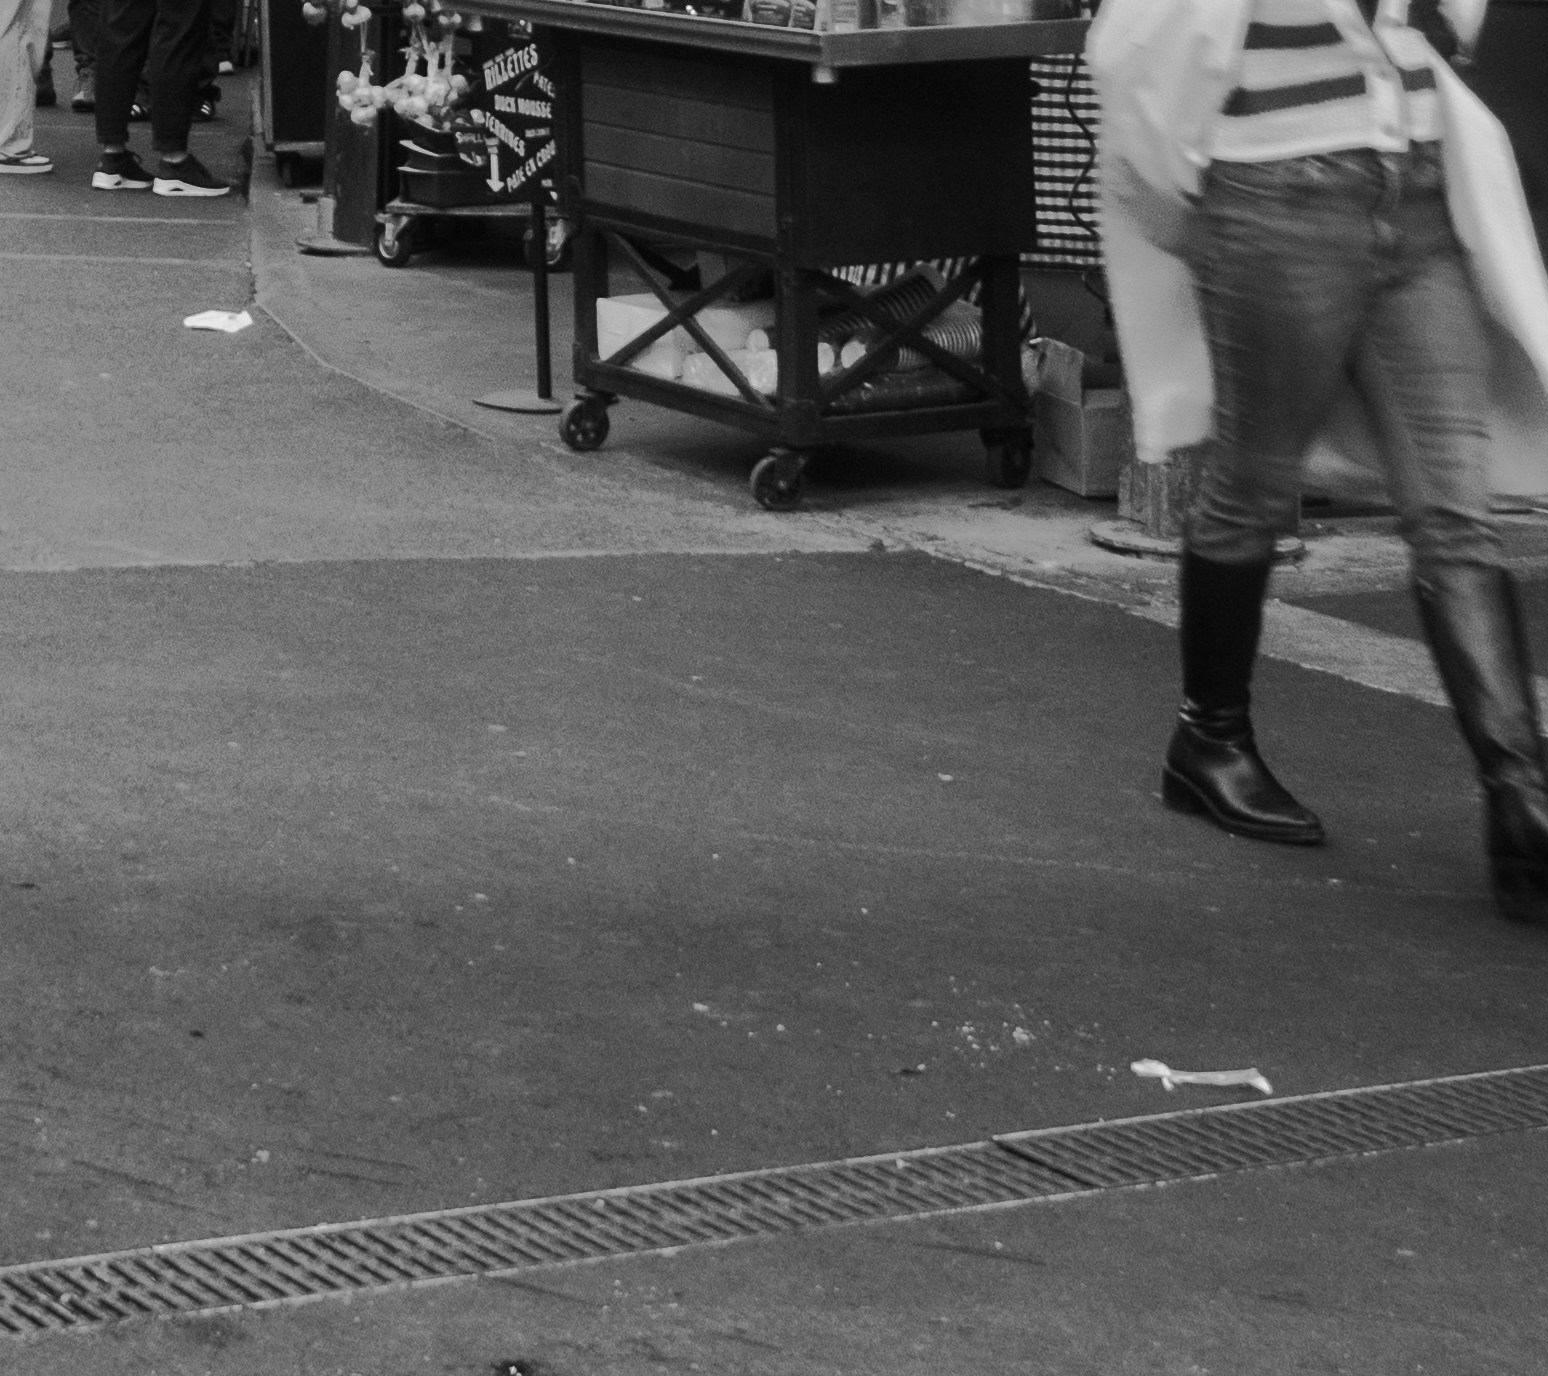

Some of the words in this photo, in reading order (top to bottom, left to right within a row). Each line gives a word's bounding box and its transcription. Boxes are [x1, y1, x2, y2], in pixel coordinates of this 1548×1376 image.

[484, 43, 538, 90] RILLETTES
[494, 94, 516, 113] DUCK
[517, 97, 552, 119] MOUSSE
[485, 111, 525, 157] TERRINES
